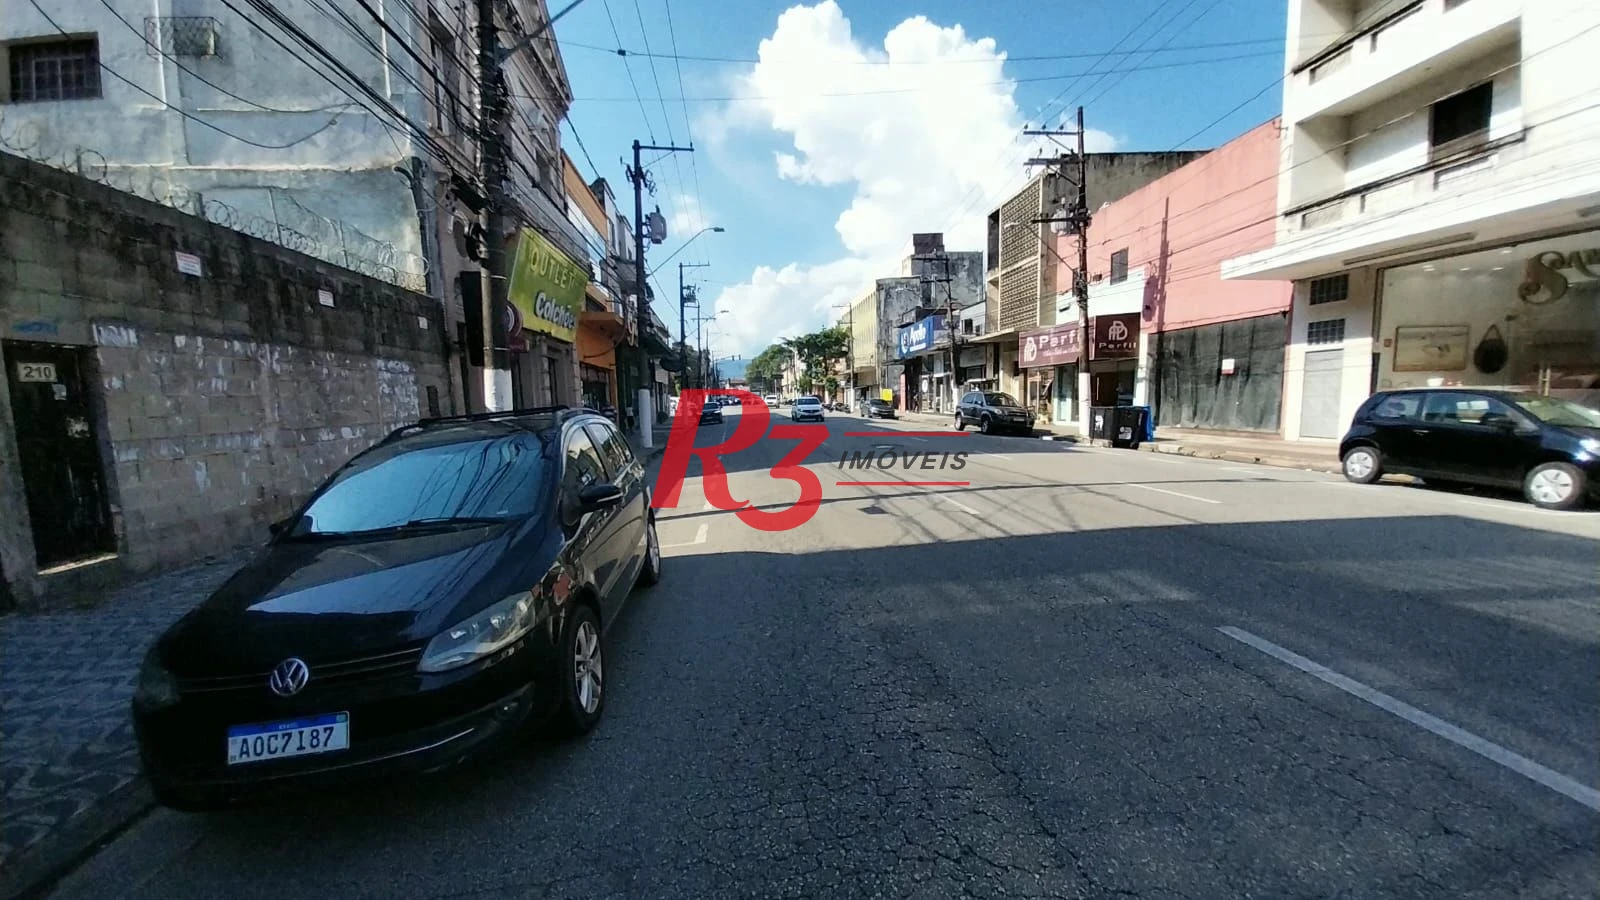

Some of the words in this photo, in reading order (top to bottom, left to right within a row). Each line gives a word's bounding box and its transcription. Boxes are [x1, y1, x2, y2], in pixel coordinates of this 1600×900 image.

[530, 246, 576, 290] OUTLET
[1039, 329, 1080, 349] Perf
[24, 366, 52, 379] 210
